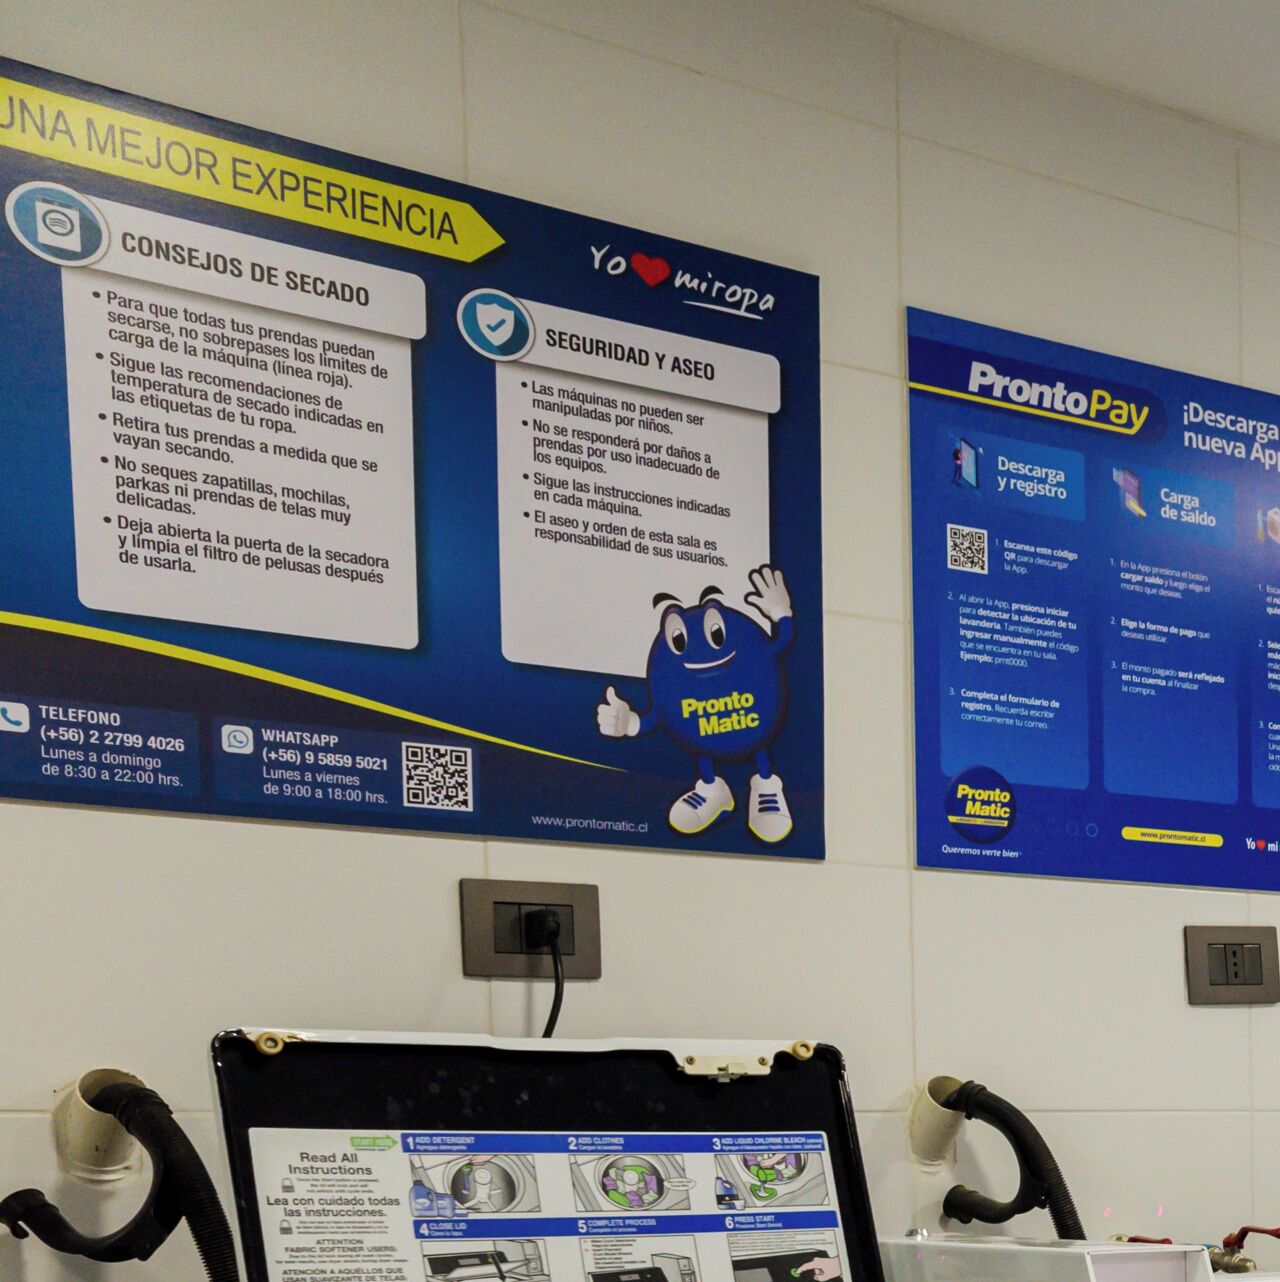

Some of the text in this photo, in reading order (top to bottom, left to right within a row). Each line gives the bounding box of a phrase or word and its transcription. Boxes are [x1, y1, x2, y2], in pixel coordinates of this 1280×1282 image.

[87, 117, 220, 185] MEJOR
[232, 156, 459, 245] EXPERIENCIA
[121, 231, 371, 307] CONSEJOS DE SECADO
[590, 244, 627, 275] Yo
[107, 291, 375, 361] Para que todas tus prendas puedan
[107, 309, 175, 338] secarse,
[179, 324, 198, 340] no
[203, 329, 290, 360] sobrepases
[294, 347, 314, 364] los
[371, 363, 388, 379] de
[545, 328, 715, 381] SEGURIDAD Y ASEO
[108, 327, 353, 390] carga de la máquina (línea roja).
[532, 380, 705, 427] Las máquinas no pueden ser
[532, 398, 673, 435] manipuladas por niños.
[1183, 401, 1279, 445] ¡Descarga
[1183, 428, 1246, 460] nueva
[997, 456, 1066, 485] Descarga
[997, 477, 1068, 500] y registro
[1160, 488, 1200, 512] Carga
[1160, 503, 1217, 527] de saldo
[1004, 540, 1035, 553] Escanea
[1036, 545, 1053, 556] este
[39, 705, 121, 727] TELEFONO
[681, 690, 755, 718] Pronto
[699, 709, 760, 737] Matic
[40, 725, 185, 752] (+56) 2 2799 4026
[262, 728, 339, 748] WHATSAPP
[41, 745, 162, 770] Lunes a domingo
[262, 749, 389, 771] (+56) 9 5859 5021
[42, 762, 184, 787] de 8:30 a 22:00 hrs.
[262, 766, 360, 786] Lunes a viernes
[263, 782, 389, 804] de 9:00 a 18:00 hrs.
[957, 783, 1010, 802] Pronto
[965, 799, 1010, 819] Matic
[532, 814, 648, 833] www.prontomatic.cl
[942, 844, 982, 859] Queremos
[984, 847, 1001, 858] verte
[1246, 838, 1256, 850] Yo
[1268, 841, 1278, 853] mi
[300, 1152, 358, 1163] Read All
[289, 1165, 372, 1176] Instructions
[266, 1196, 400, 1206] Lea con cuidado todas
[284, 1207, 387, 1217] las instrucciones.
[419, 1223, 429, 1236] 4
[725, 1216, 734, 1229] 6
